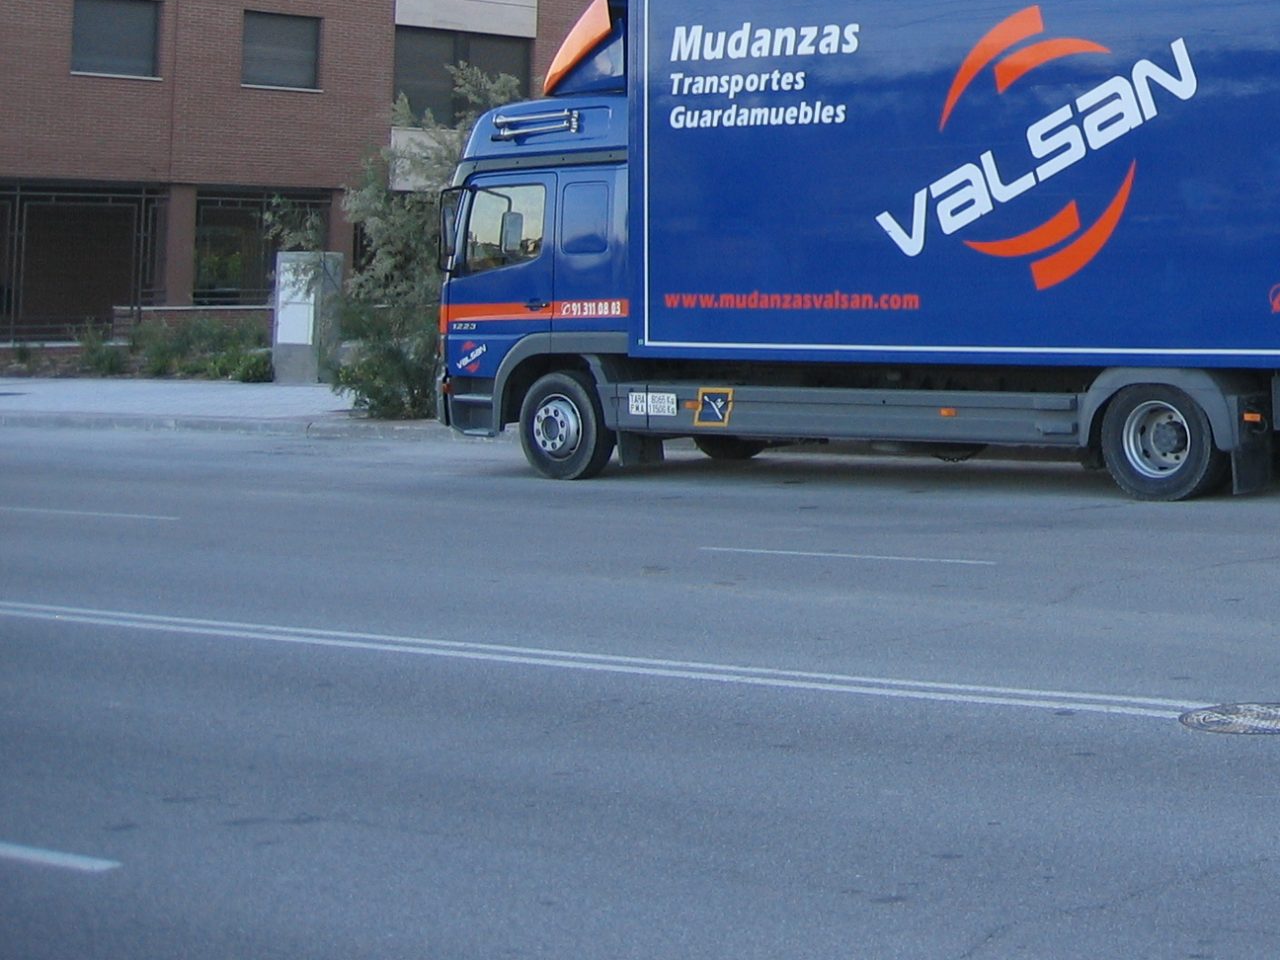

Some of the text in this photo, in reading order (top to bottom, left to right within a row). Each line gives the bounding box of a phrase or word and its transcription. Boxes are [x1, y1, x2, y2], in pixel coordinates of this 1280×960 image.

[670, 22, 860, 61] Mudanzas
[670, 69, 806, 99] Transportes
[670, 101, 847, 129] Guardamuebles
[572, 302, 581, 316] 91
[582, 301, 596, 316] 311
[598, 301, 609, 316] 08
[664, 289, 920, 310] www.mudanzasvalsan.com
[452, 322, 477, 330] 1223
